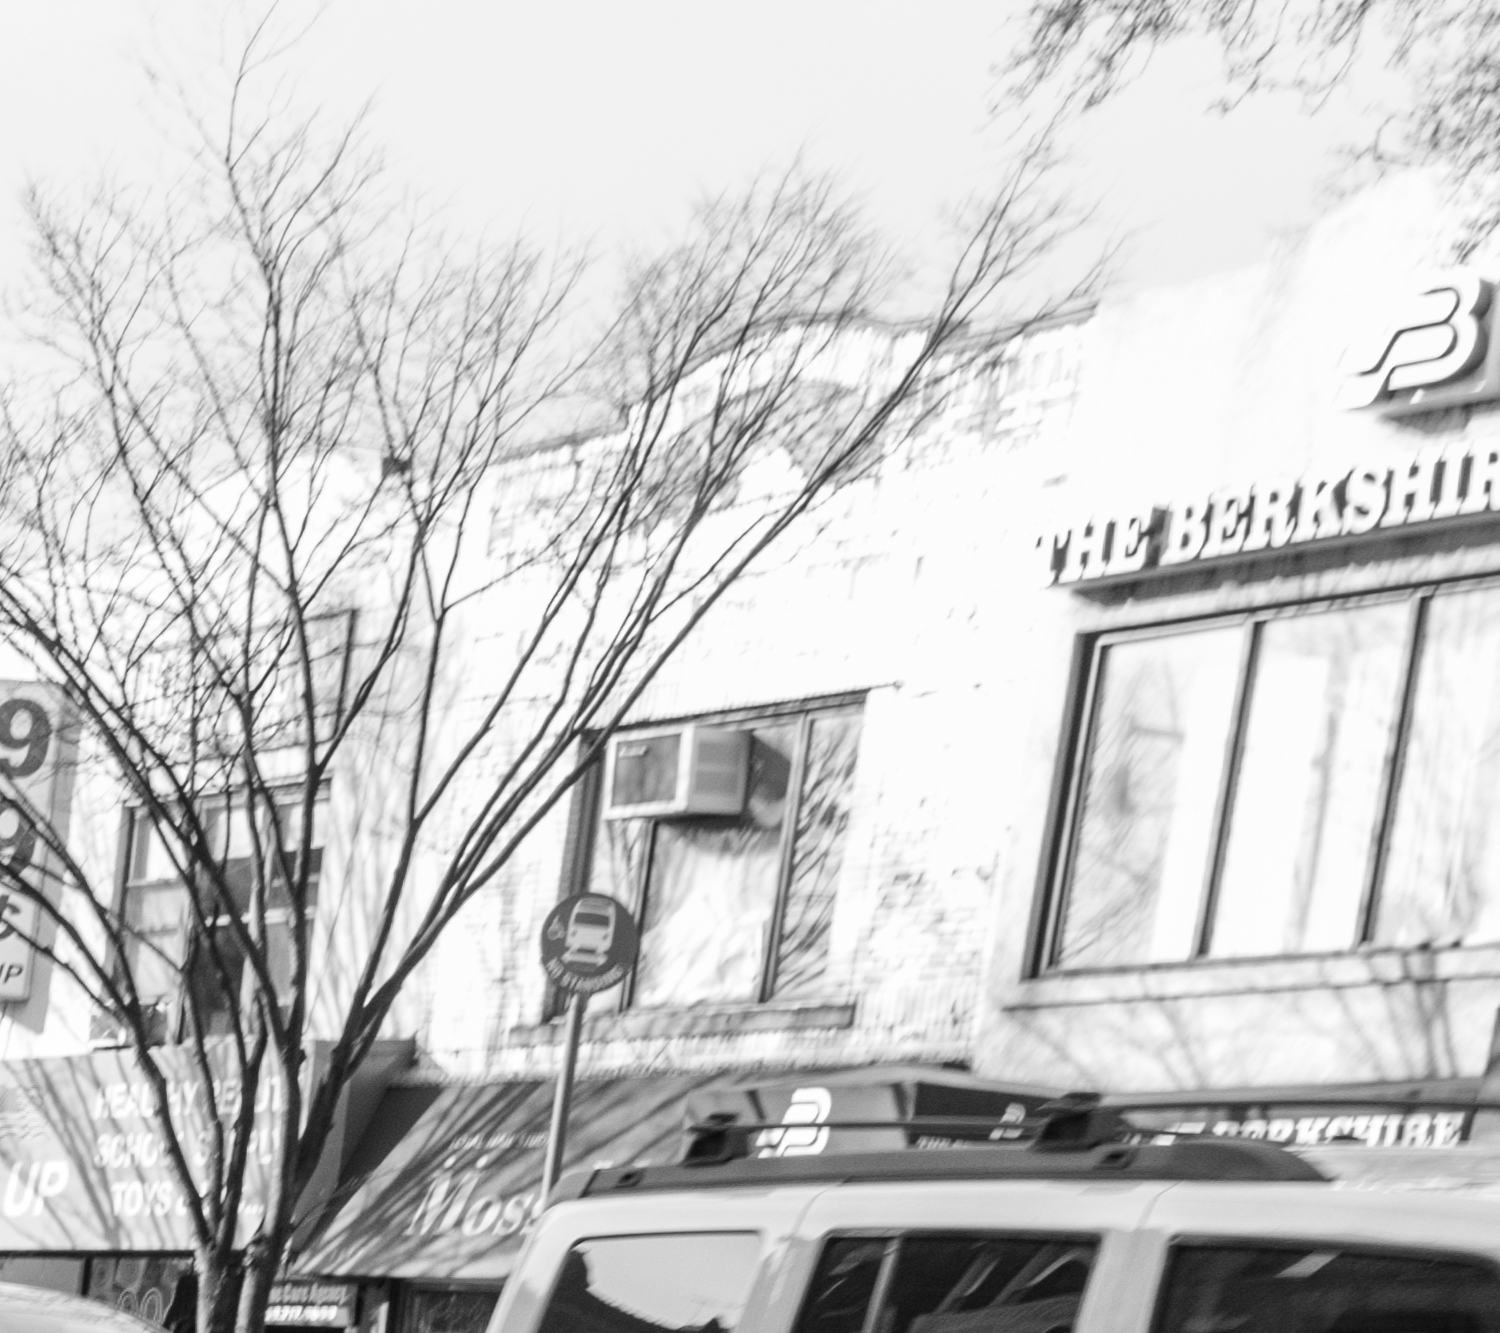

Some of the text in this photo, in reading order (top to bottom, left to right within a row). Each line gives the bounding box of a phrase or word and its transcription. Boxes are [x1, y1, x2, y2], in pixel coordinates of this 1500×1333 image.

[1036, 508, 1150, 586] THE
[92, 1078, 200, 1120] HEALHY
[3, 1160, 70, 1218] UP
